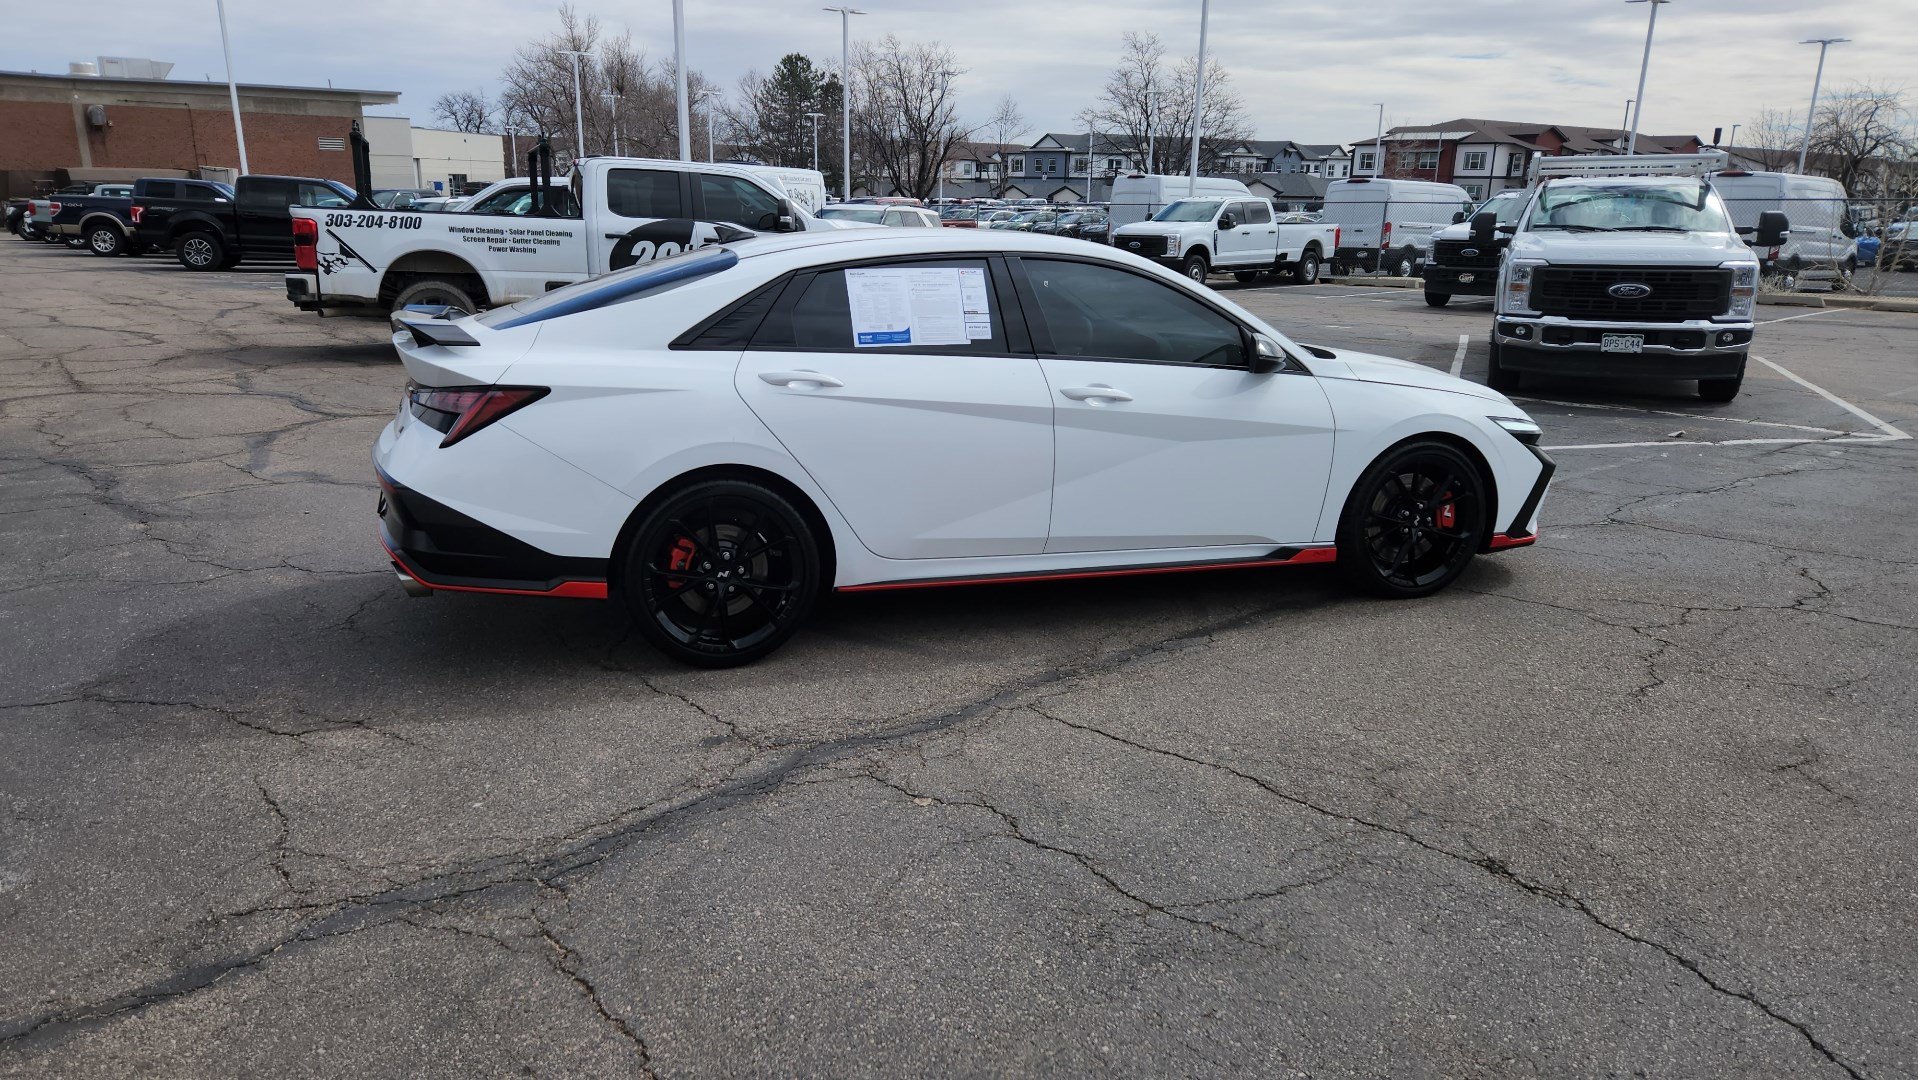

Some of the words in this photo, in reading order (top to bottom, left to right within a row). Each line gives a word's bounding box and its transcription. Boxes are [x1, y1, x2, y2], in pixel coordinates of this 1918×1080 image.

[325, 213, 422, 229] 303-204-8100
[448, 226, 474, 234] Window
[475, 227, 504, 236] Cleaning
[508, 228, 526, 236] Solar
[545, 230, 573, 238] Cleaning
[462, 235, 486, 243] Screen
[486, 236, 507, 245] Repair
[532, 238, 561, 247] Cleaning
[488, 245, 508, 253] Power
[508, 246, 537, 254] Washing
